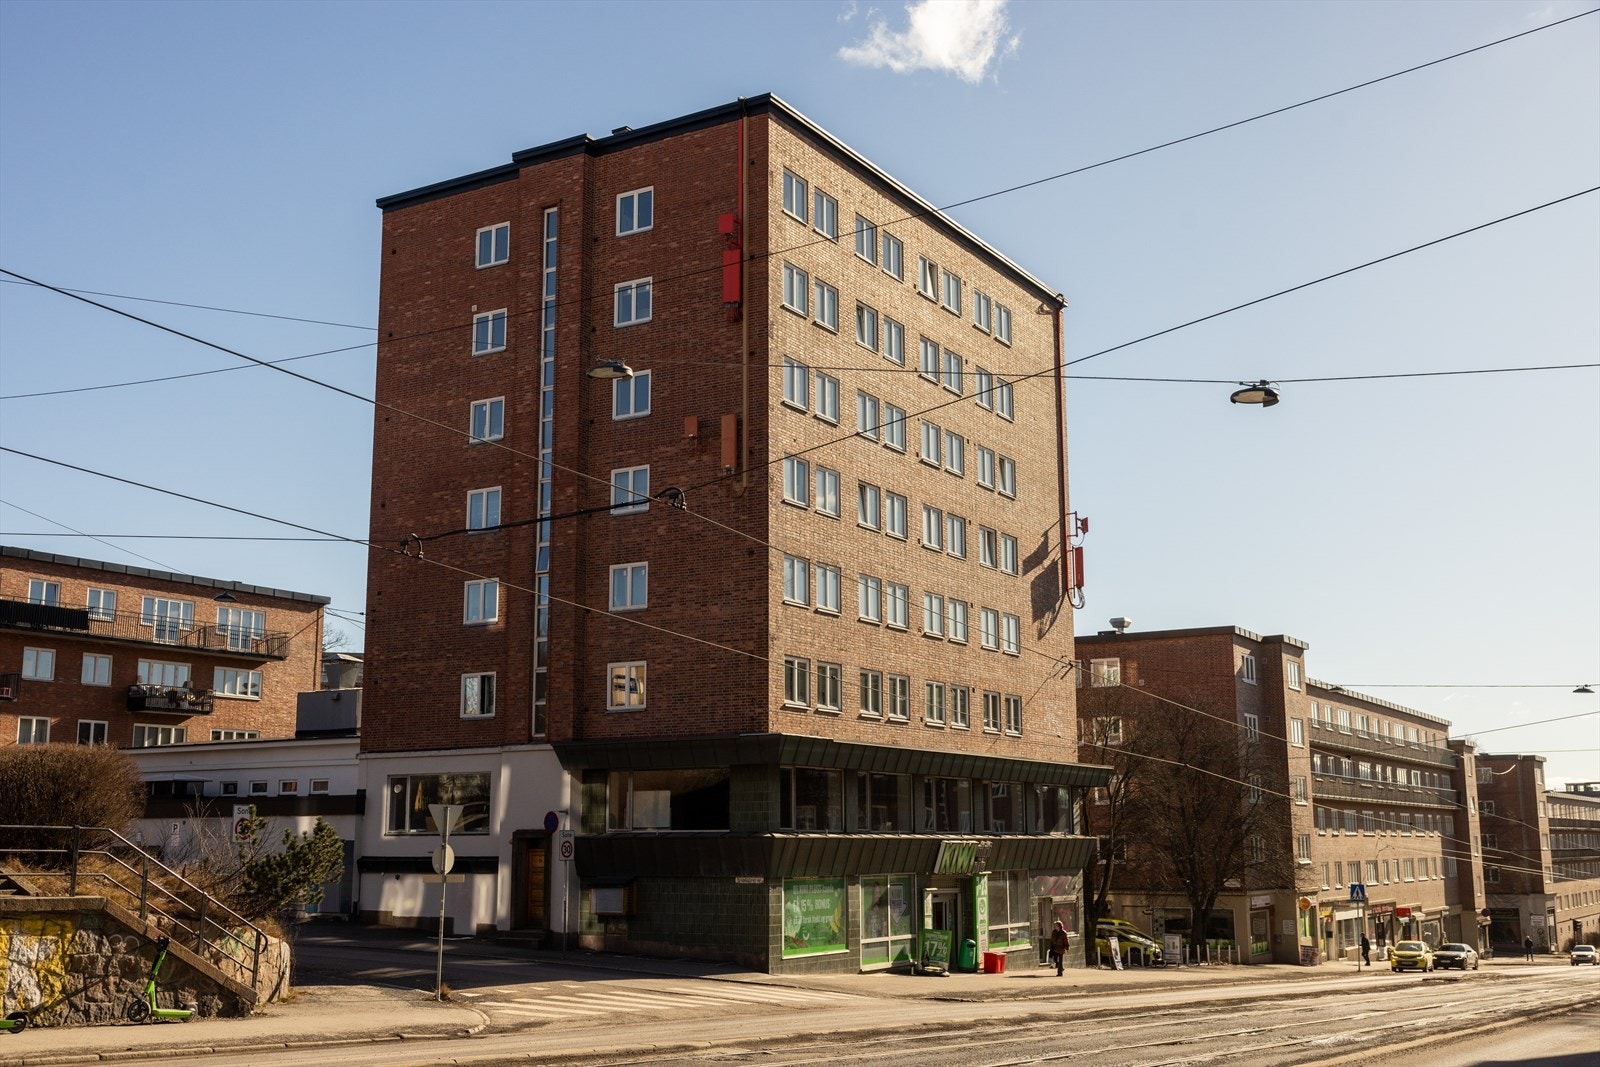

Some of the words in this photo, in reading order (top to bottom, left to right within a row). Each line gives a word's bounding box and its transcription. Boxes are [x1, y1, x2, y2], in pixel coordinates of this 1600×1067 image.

[563, 845, 570, 853] 30
[940, 843, 977, 873] KIWI
[815, 898, 830, 910] BONUS
[925, 941, 948, 957] 17%
